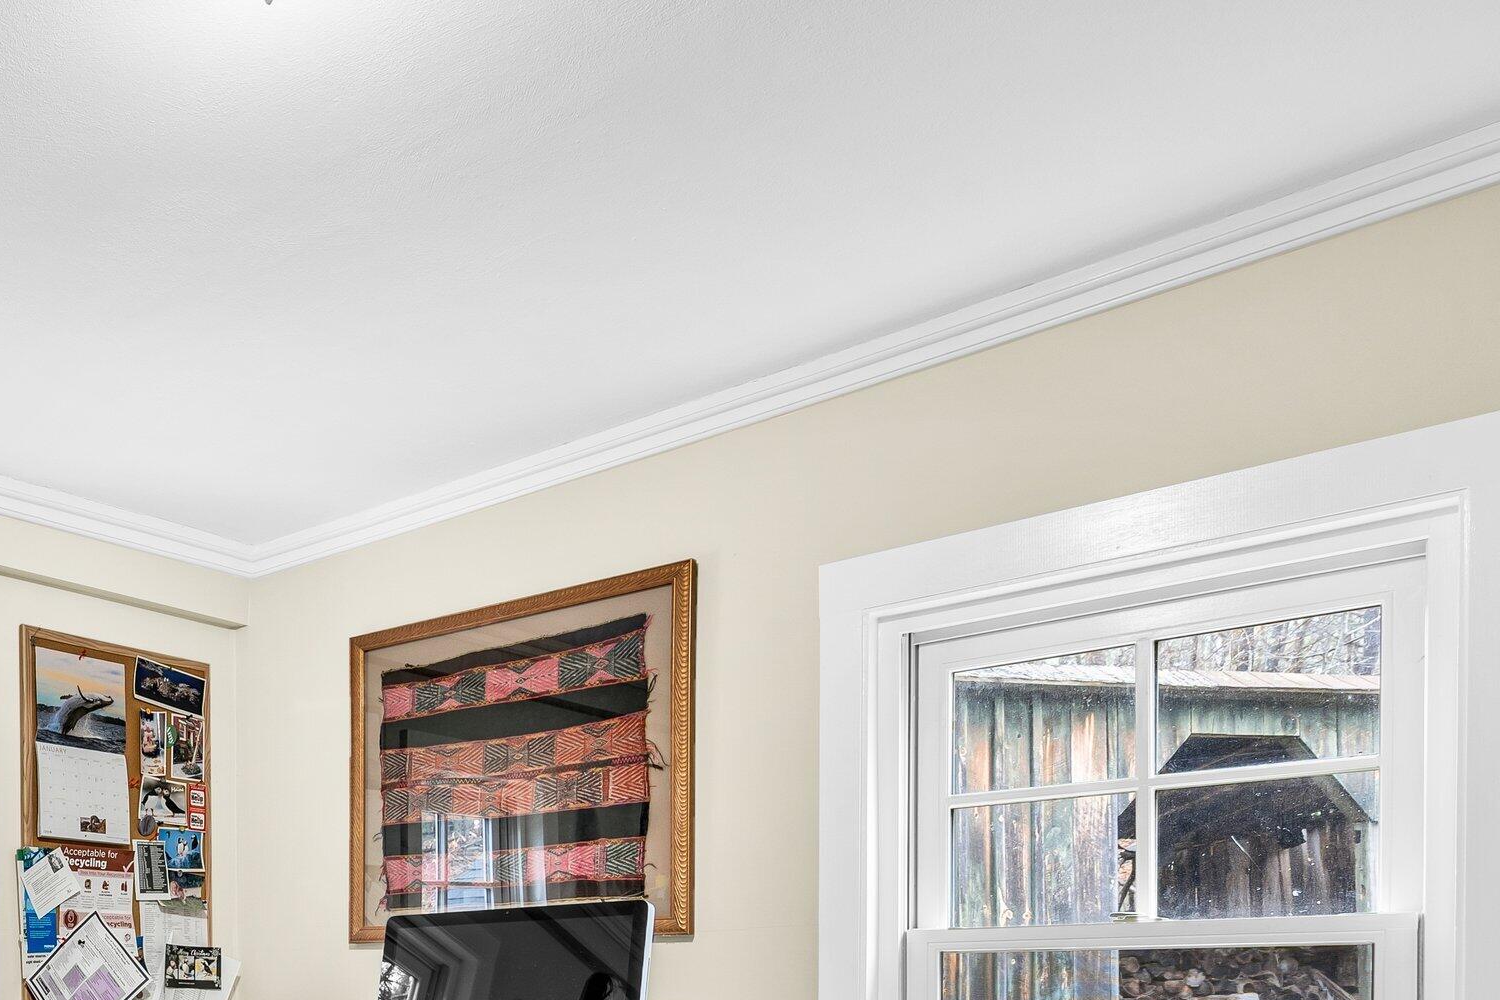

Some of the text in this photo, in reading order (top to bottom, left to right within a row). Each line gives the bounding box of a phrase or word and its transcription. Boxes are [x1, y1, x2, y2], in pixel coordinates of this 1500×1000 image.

[39, 744, 67, 754] JANUARY
[63, 846, 118, 859] Acceptable for
